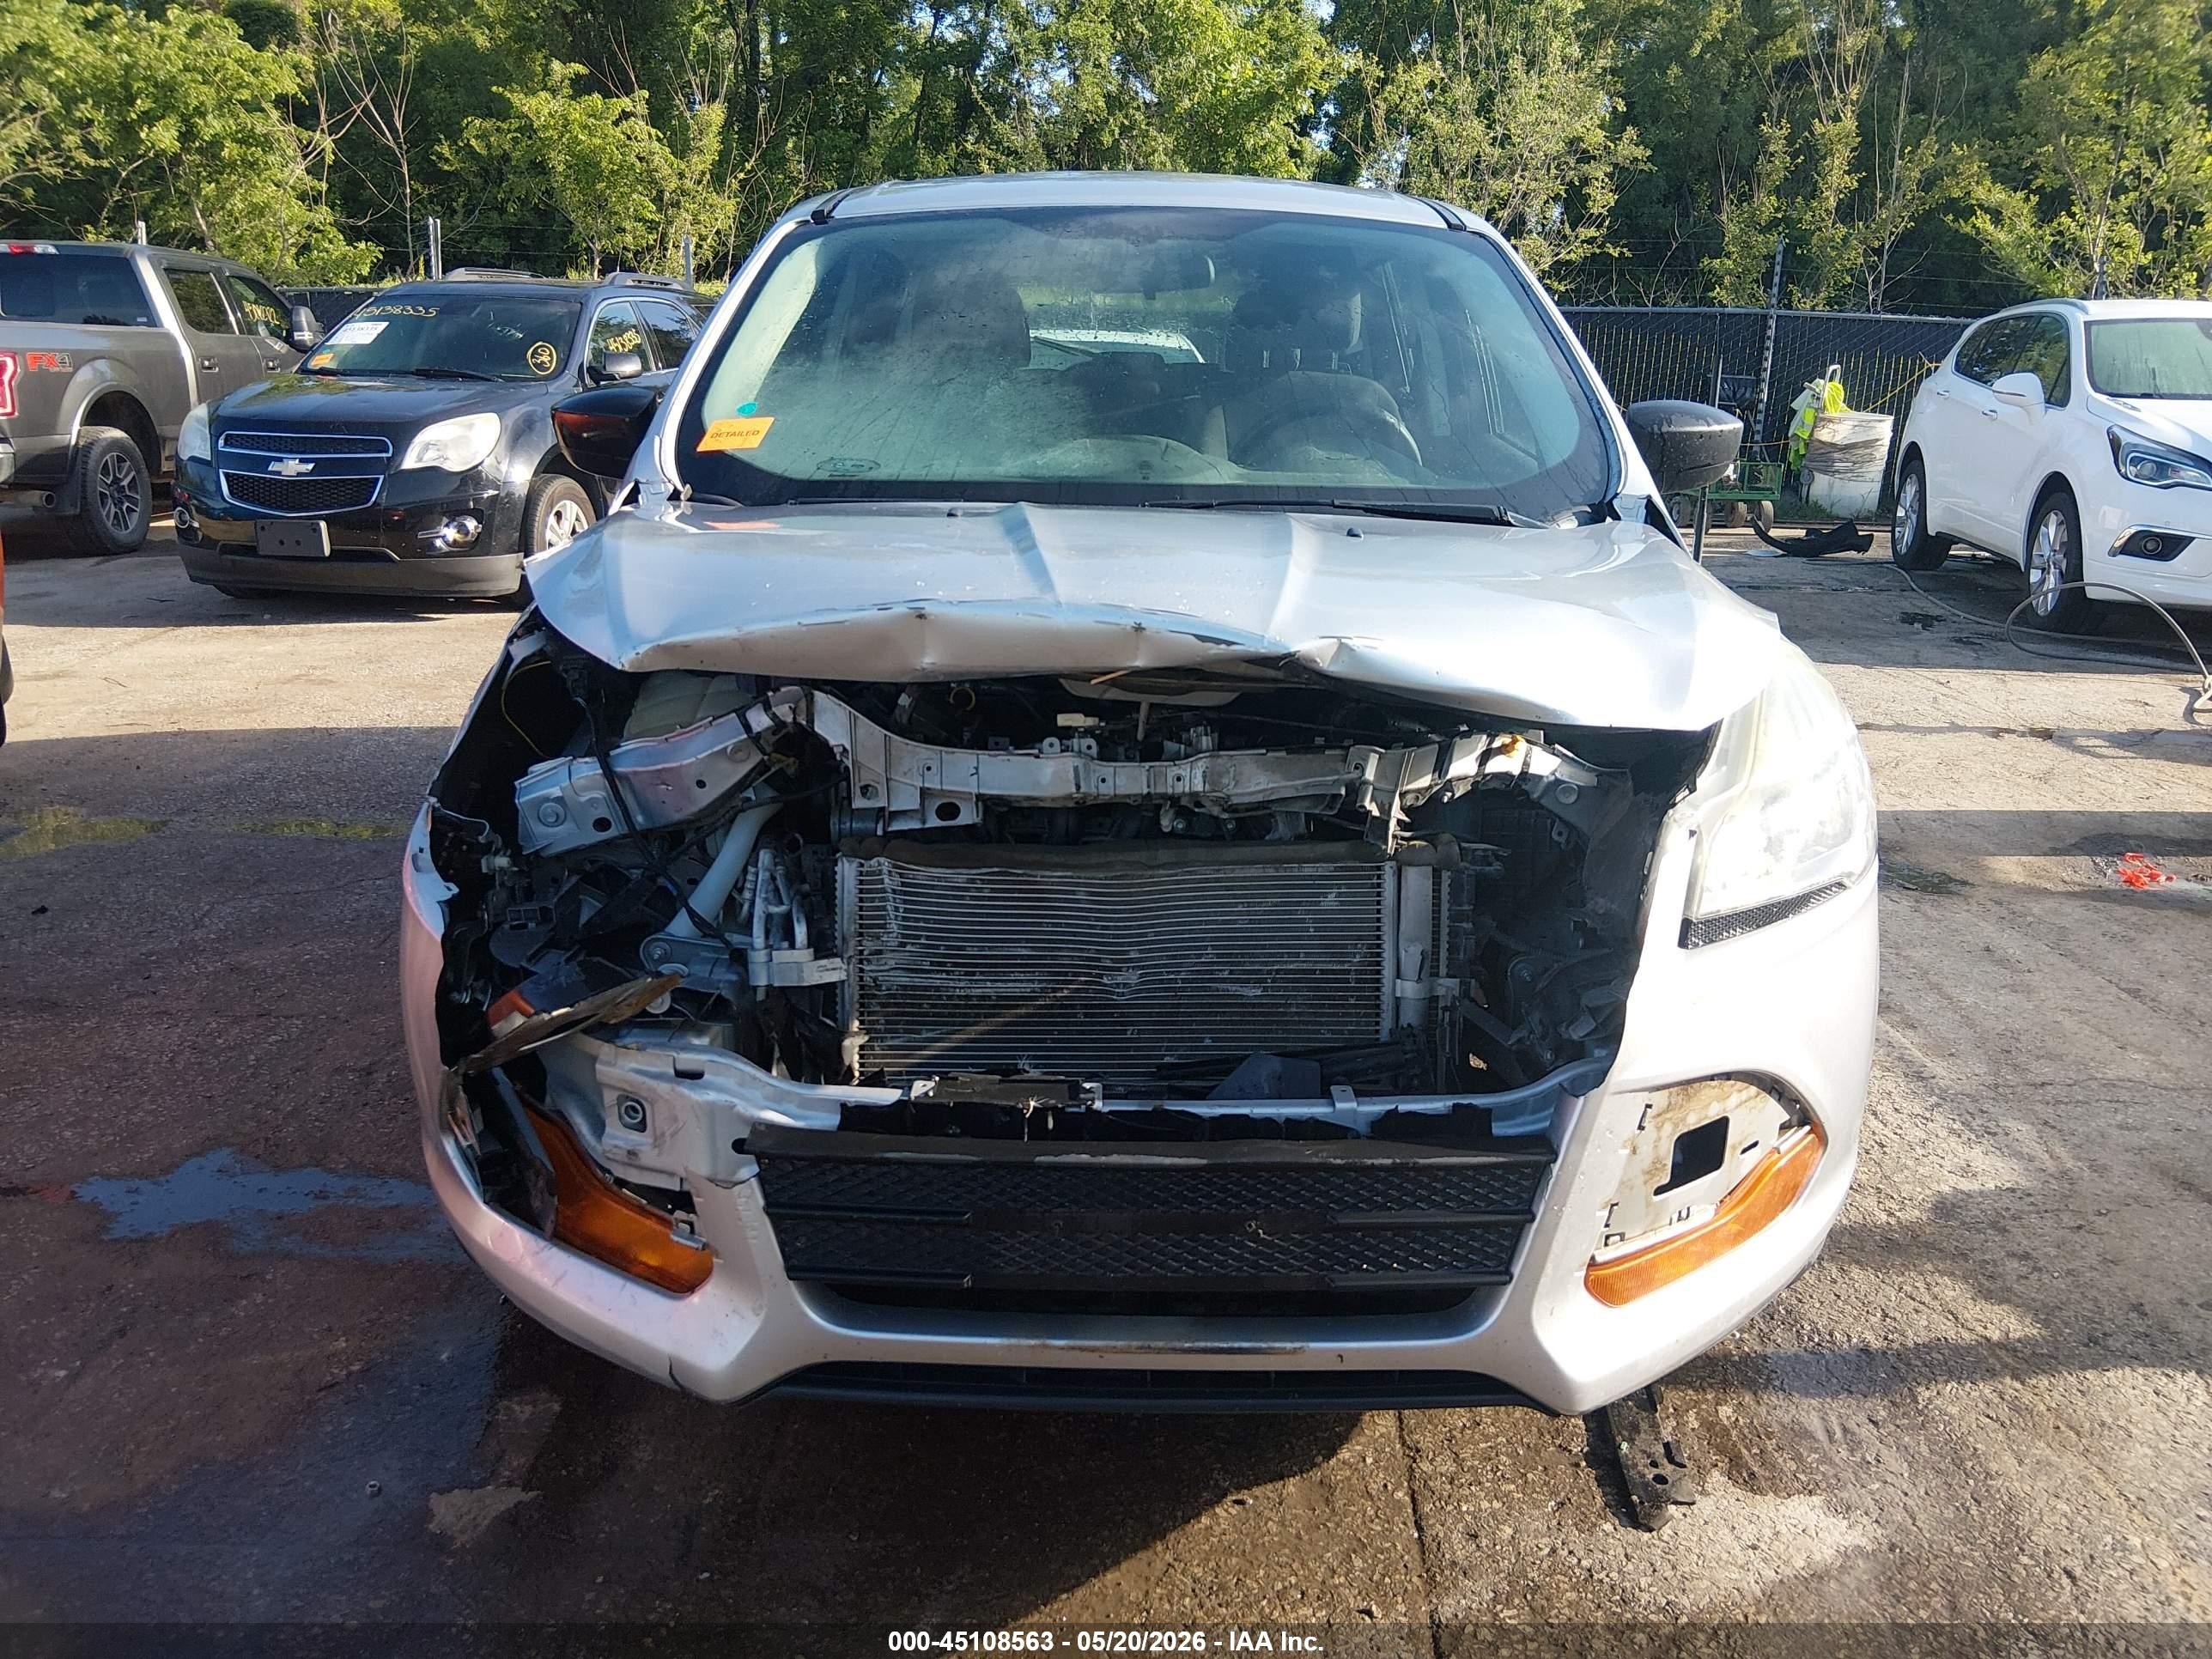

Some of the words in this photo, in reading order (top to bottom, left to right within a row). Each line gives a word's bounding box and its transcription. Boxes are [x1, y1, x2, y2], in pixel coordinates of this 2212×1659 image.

[353, 304, 441, 319] 45138335
[27, 352, 73, 372] FX4
[710, 428, 761, 440] DETAILED
